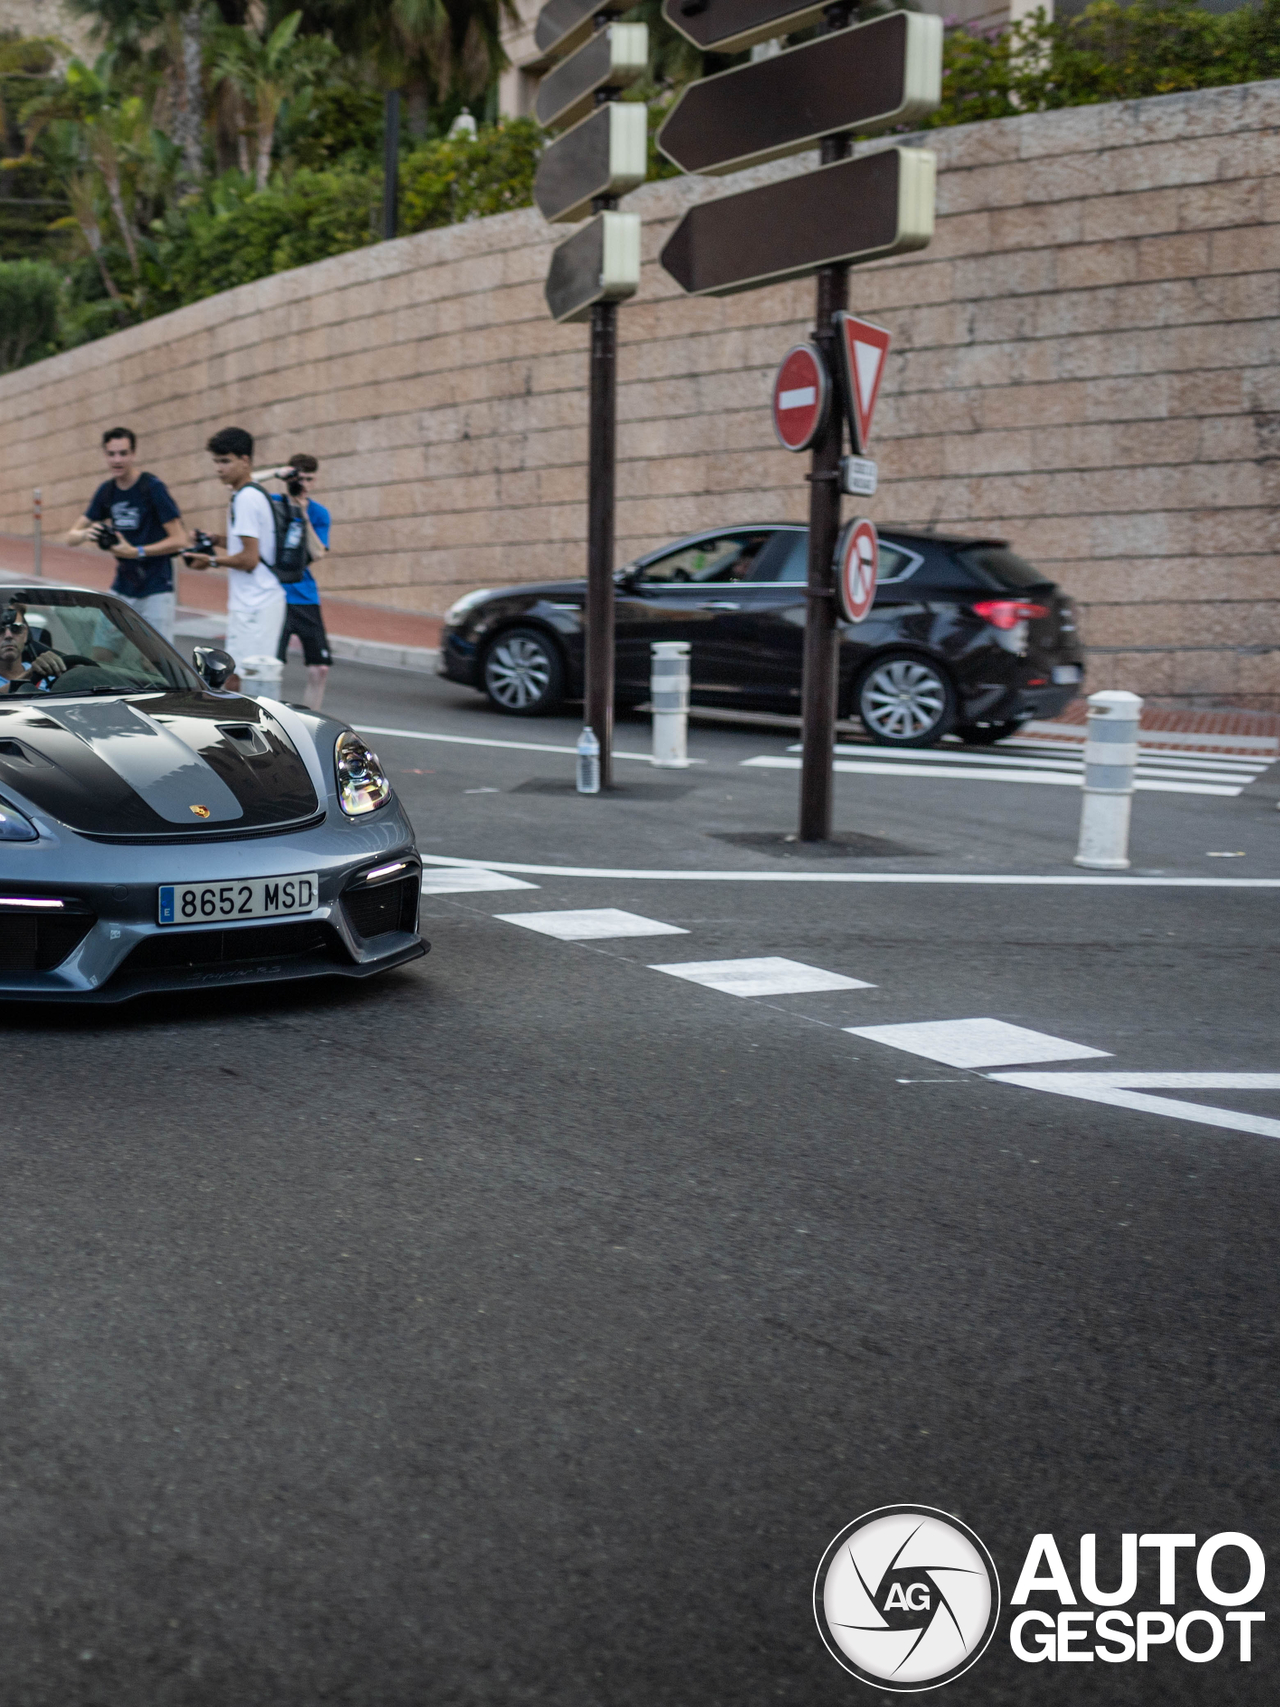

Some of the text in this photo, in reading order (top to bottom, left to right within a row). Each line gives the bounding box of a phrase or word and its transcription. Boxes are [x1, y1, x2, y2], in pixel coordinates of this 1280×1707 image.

[164, 880, 312, 917] E 8652 MSD
